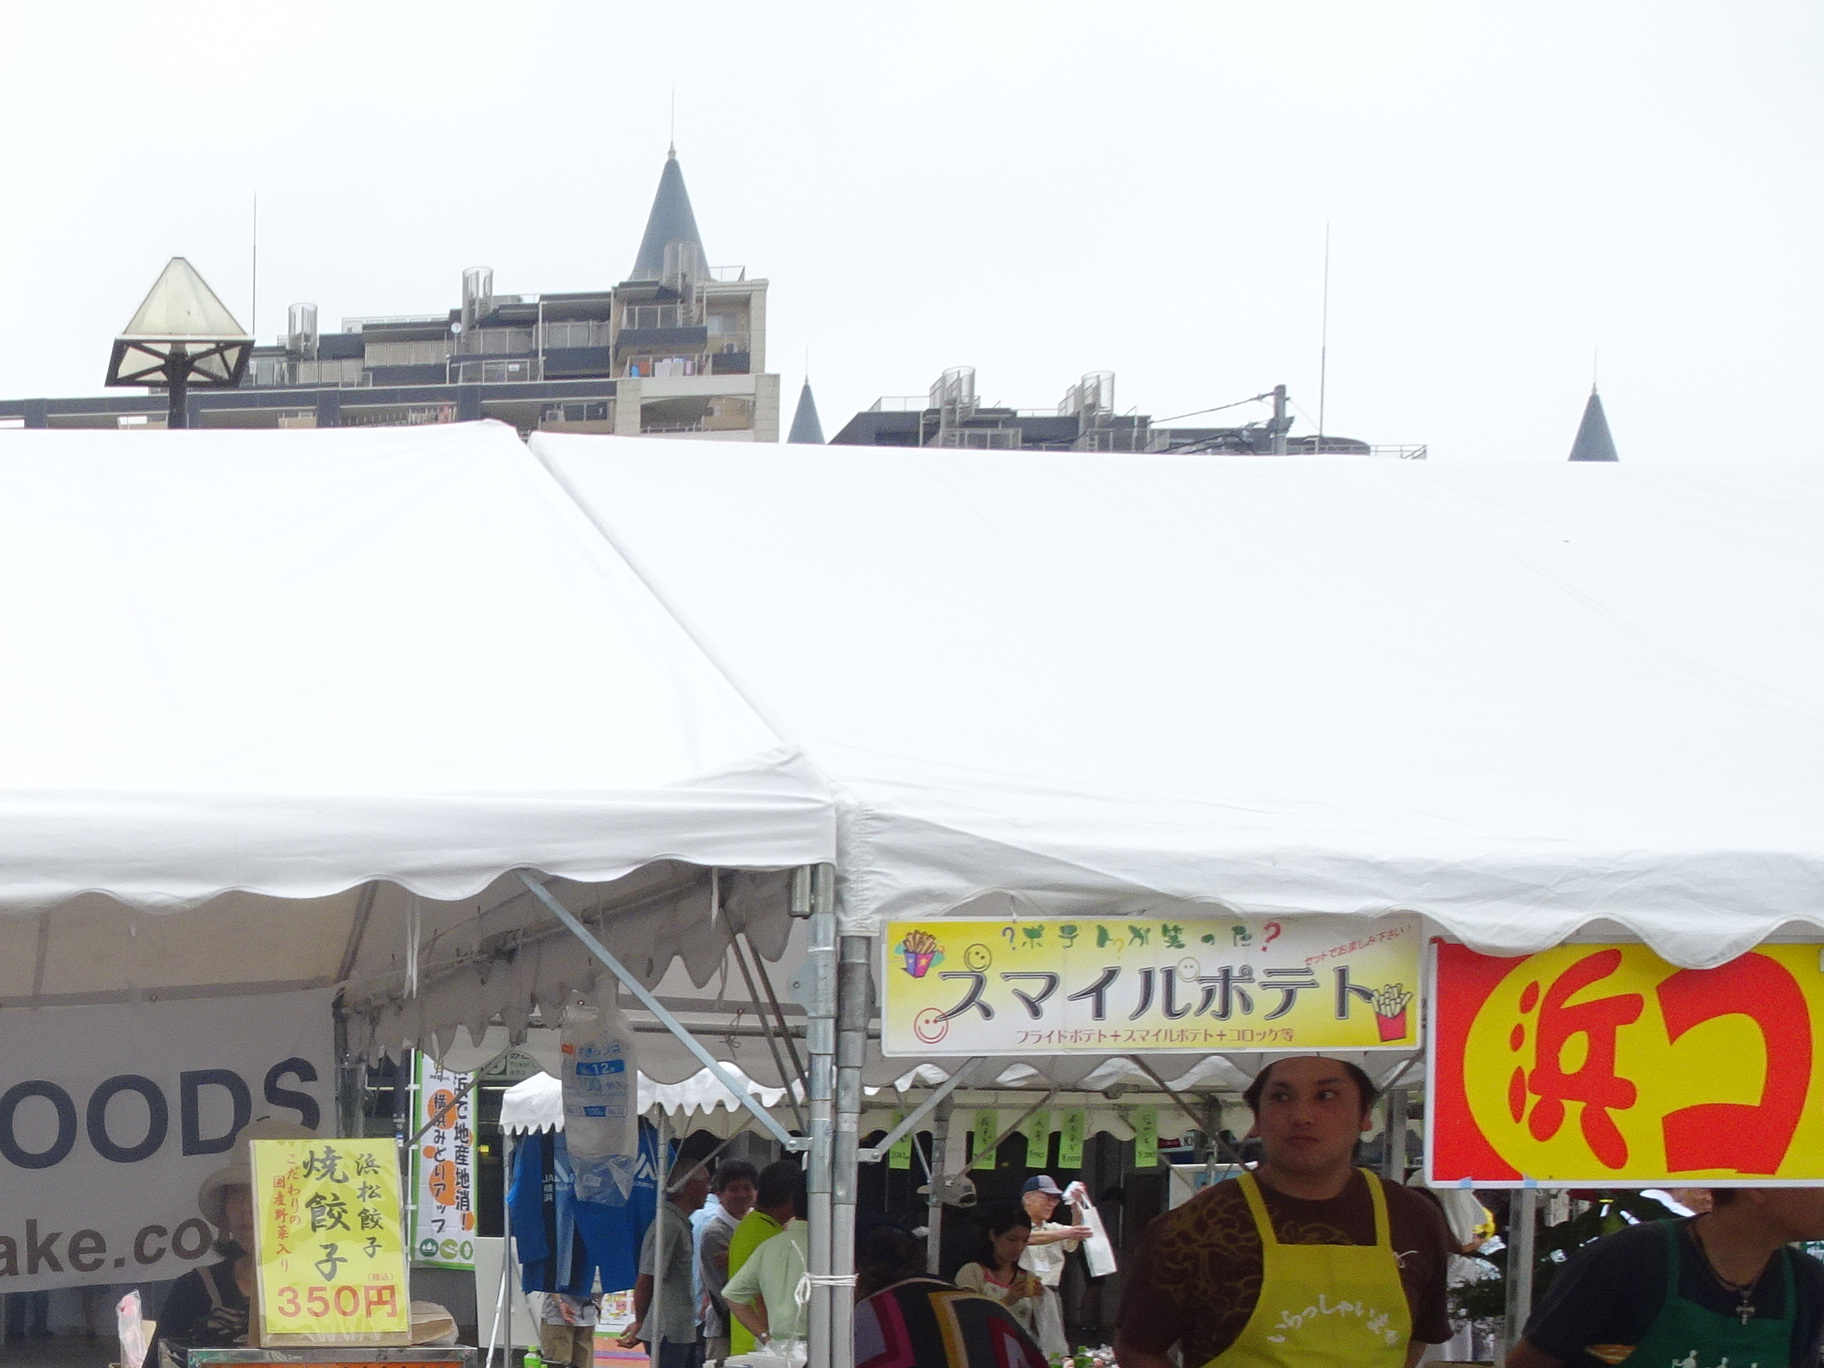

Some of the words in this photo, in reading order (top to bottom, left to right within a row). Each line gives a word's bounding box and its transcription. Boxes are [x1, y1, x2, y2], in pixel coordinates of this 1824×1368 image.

[936, 966, 1375, 1021] スマイルポテト
[287, 1153, 301, 1226] こだわりの
[453, 1071, 471, 1231] 浜で地産地消!
[273, 1175, 291, 1273] 国産野菜入り
[302, 1146, 351, 1282] 焼餃子
[354, 1153, 384, 1259] 浜松餃子
[277, 1284, 398, 1319] 350円
